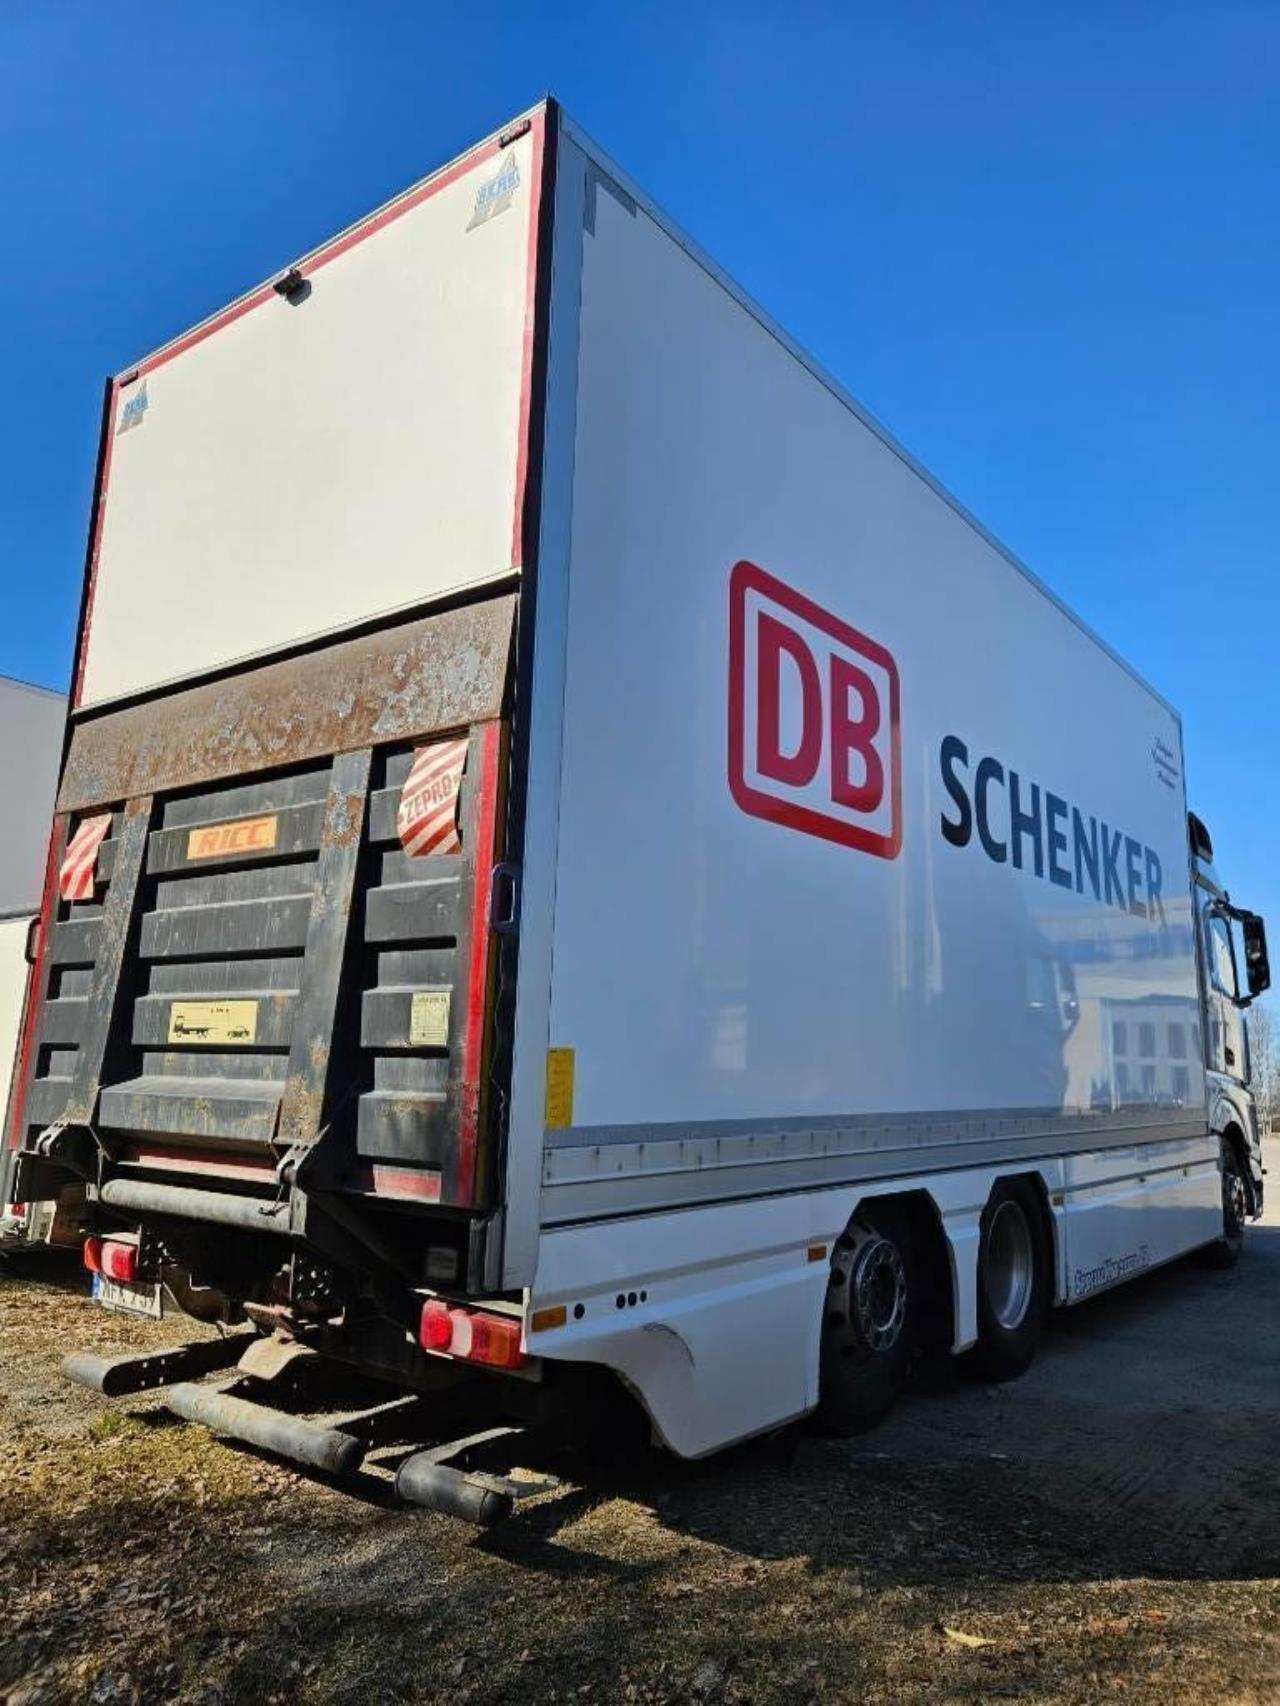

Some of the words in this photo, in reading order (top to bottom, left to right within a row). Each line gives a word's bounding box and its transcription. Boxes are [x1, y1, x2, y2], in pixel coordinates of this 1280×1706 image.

[404, 773, 453, 823] ZEPRO
[757, 609, 885, 813] DB
[940, 735, 1168, 926] SCHENKER
